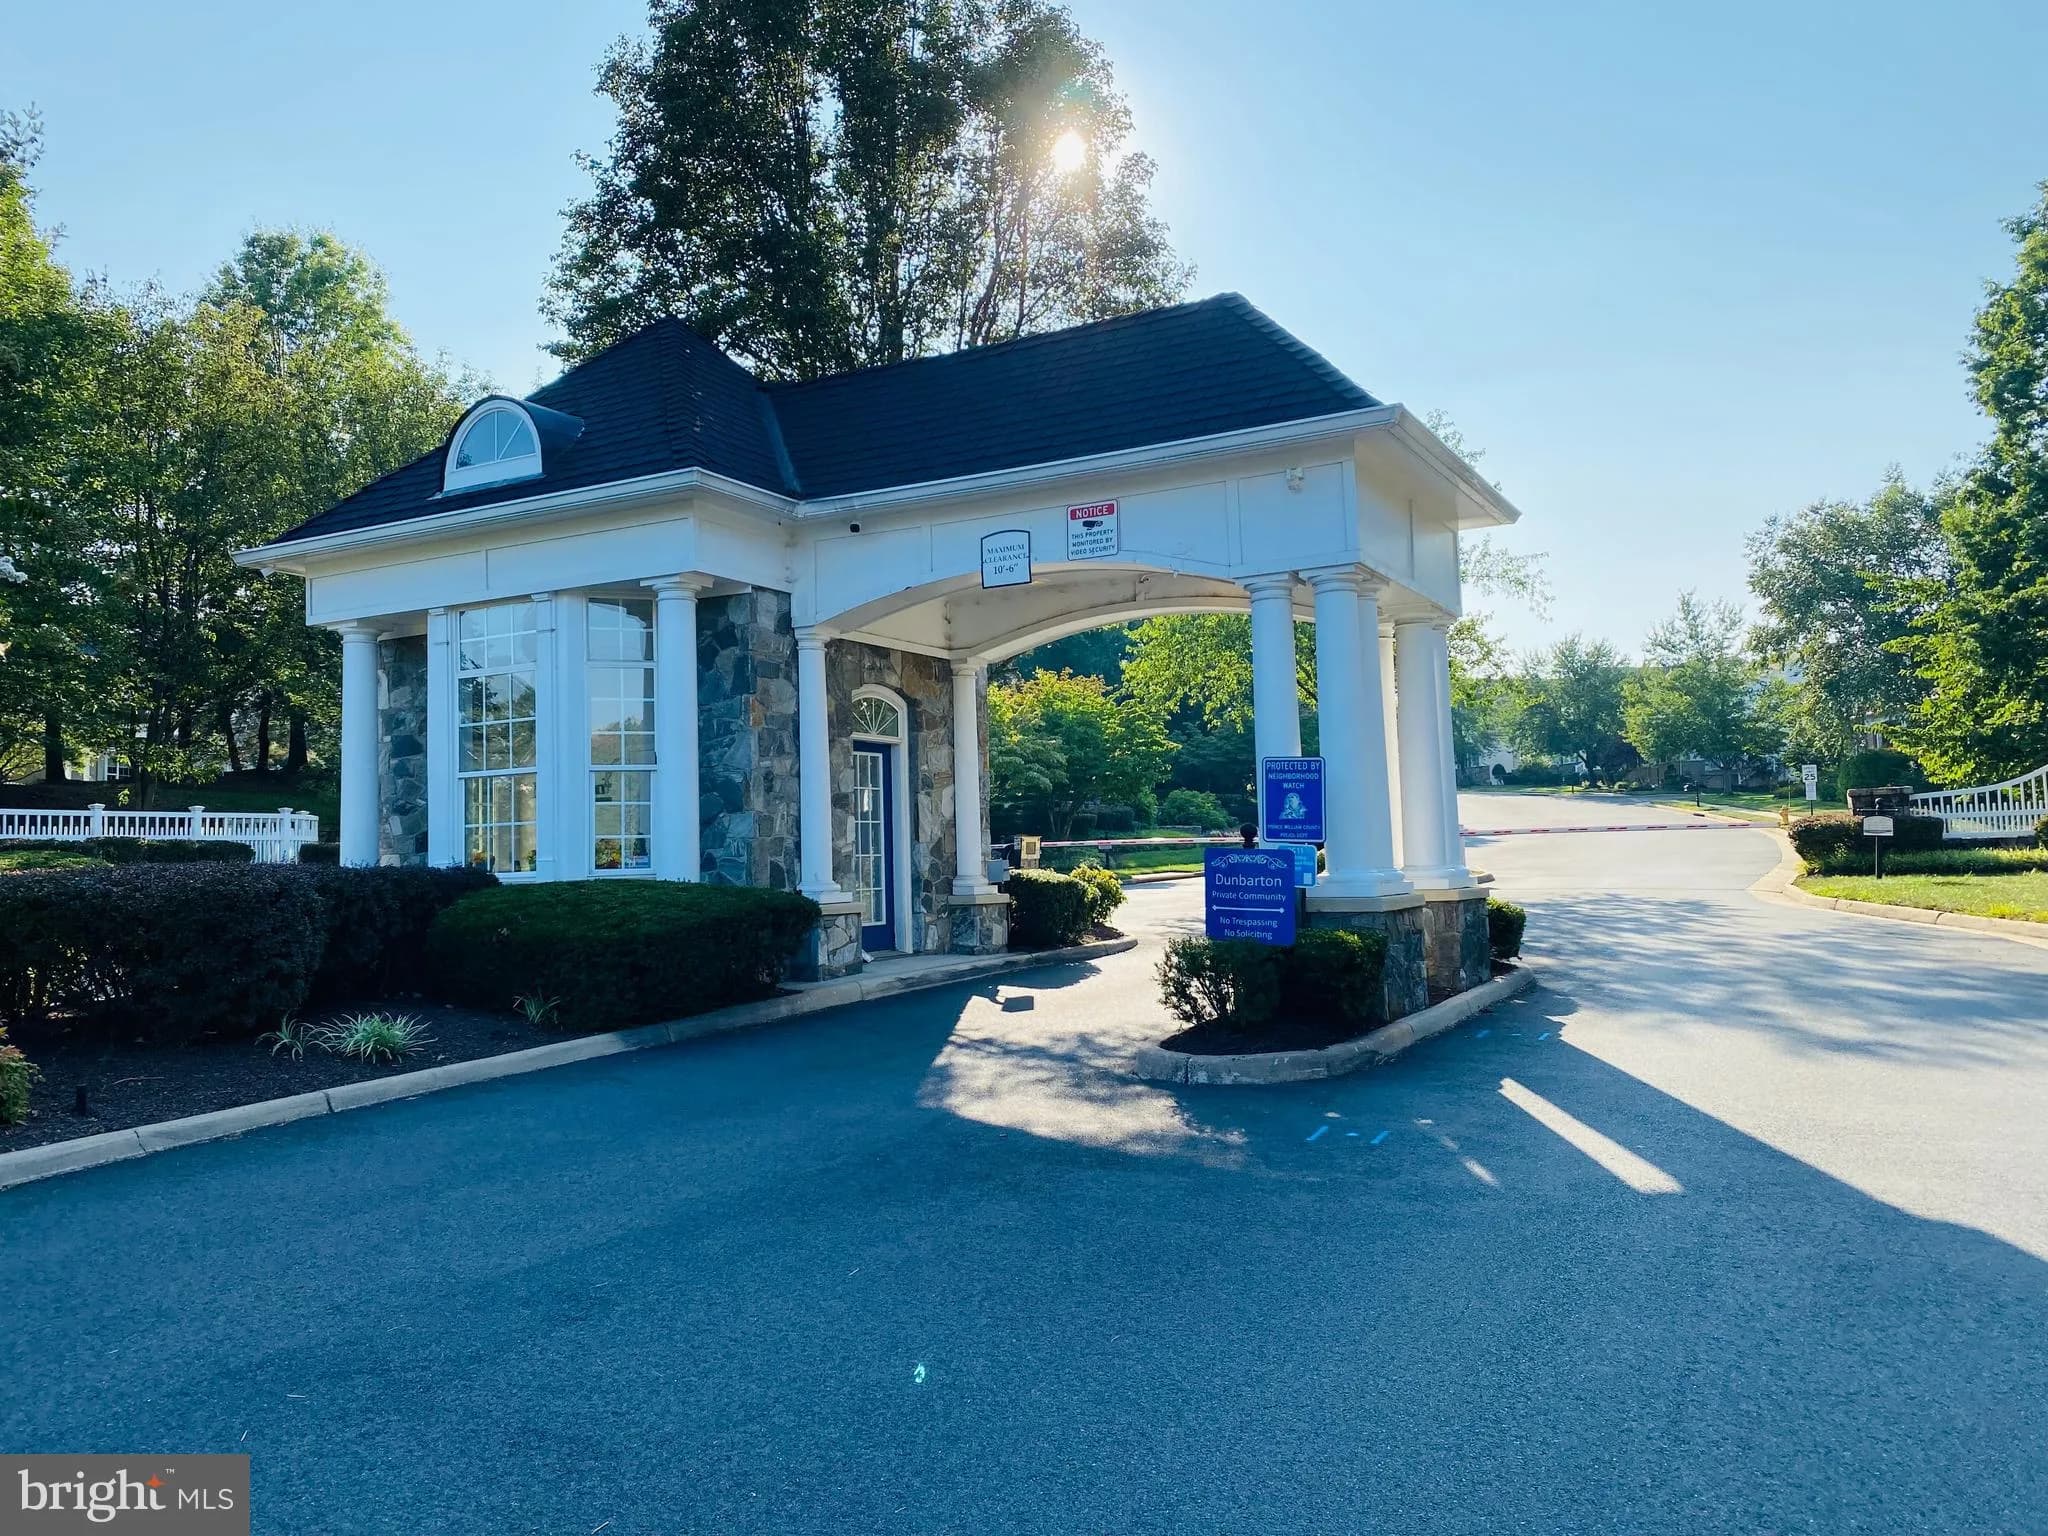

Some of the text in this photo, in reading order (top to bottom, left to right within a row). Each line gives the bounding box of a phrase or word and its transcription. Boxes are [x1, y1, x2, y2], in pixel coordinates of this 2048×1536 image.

[1076, 505, 1108, 518] NOTICE
[1085, 529, 1113, 537] PROPERTY
[1072, 538, 1103, 547] MONITORED
[987, 544, 1024, 554] MAXIMUM
[1071, 545, 1114, 556] VIDEO SECURITY
[984, 552, 1026, 564] CLEARANCE
[1266, 761, 1320, 770] PROTECTED BY
[1215, 873, 1282, 887] Dunbarton
[1212, 890, 1286, 902] Private Community
[1220, 916, 1278, 928] No Trespassing
[1224, 928, 1273, 940] No Soliciting
